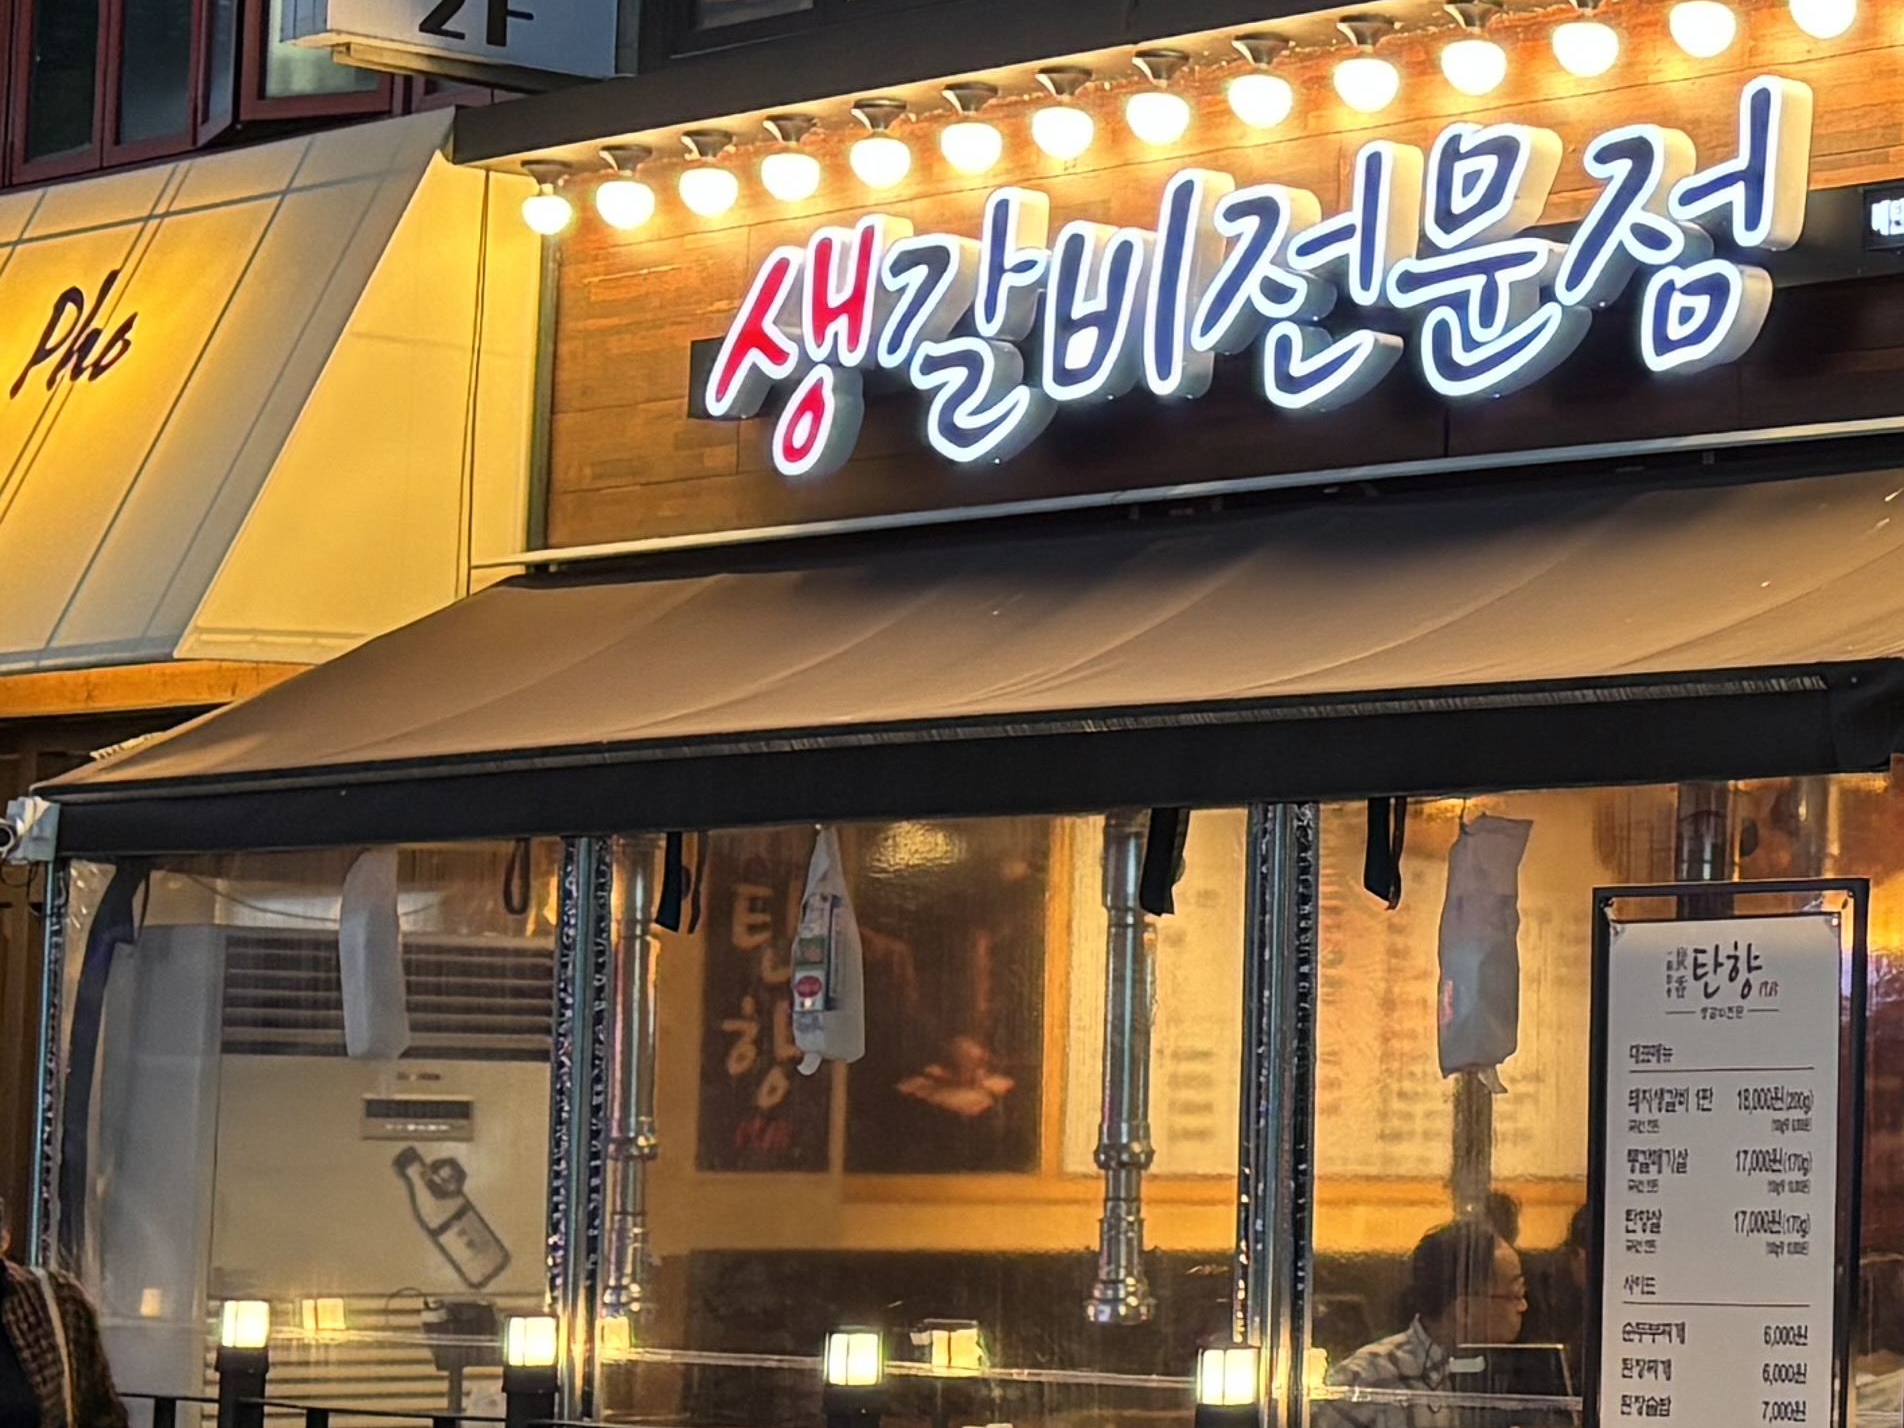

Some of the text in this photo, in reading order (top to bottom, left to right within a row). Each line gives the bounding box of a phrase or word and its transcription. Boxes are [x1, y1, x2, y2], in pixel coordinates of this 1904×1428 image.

[706, 75, 1797, 480] 생갈비전문점
[10, 268, 140, 401] Pho
[1693, 940, 1763, 1000] 탄향
[1764, 1324, 1808, 1347] 6,000원
[1621, 1357, 1808, 1385] 된장찌개 6,000원
[1762, 1400, 1807, 1423] 7,000원
